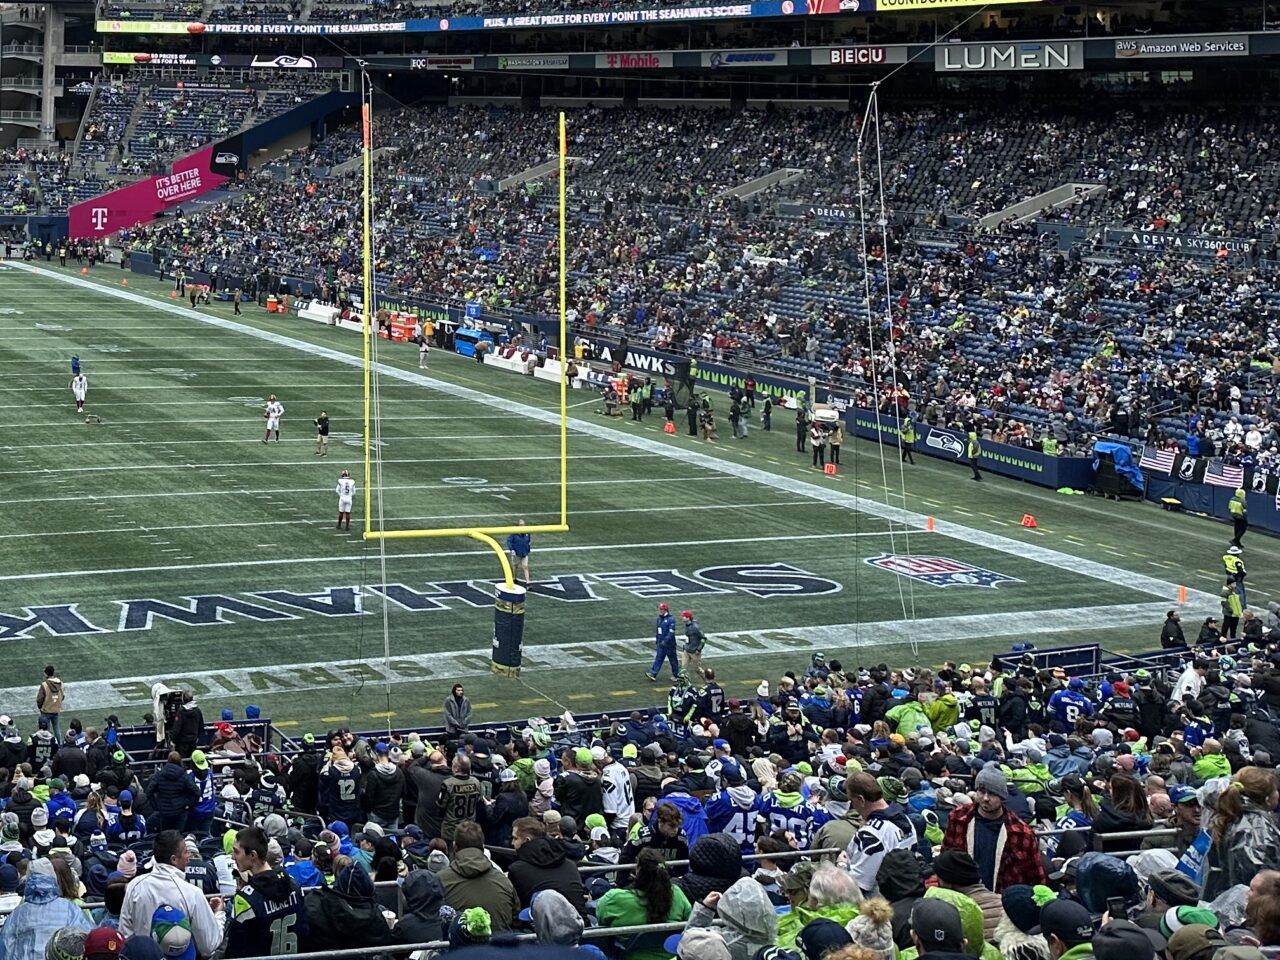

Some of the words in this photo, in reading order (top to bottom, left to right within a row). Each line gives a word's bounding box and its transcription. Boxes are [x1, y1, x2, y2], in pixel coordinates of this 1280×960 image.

[506, 18, 513, 26] A
[514, 16, 540, 26] GREAT
[542, 16, 564, 24] PRIZE
[565, 14, 582, 24] FOR
[584, 13, 609, 22] EVERY
[612, 11, 639, 21] POINT
[641, 10, 658, 20] THE
[659, 7, 712, 19] SEAHAWKS
[713, 4, 752, 17] SCORE!
[216, 24, 241, 32] PRIZE
[243, 24, 261, 32] FOR
[263, 24, 292, 32] EVERY
[294, 24, 322, 33] POINT
[324, 24, 340, 32] THE
[340, 23, 378, 32] SEAHAWKS
[380, 22, 406, 31] SCORE!
[945, 44, 1069, 69] LUMEN
[1116, 42, 1136, 50] aws
[1140, 44, 1177, 53] Amazon
[1180, 43, 1200, 52] Web
[1205, 42, 1244, 51] Services
[156, 174, 170, 190] IT'S
[170, 167, 200, 185] BETTER
[157, 184, 180, 199] OVER
[180, 178, 202, 192] HERE
[92, 208, 108, 230] T
[818, 208, 846, 218] DELTA
[854, 700, 860, 714] 6
[980, 708, 995, 724] 14
[1066, 705, 1080, 722] 8
[338, 779, 356, 800] 12
[454, 794, 478, 818] 80
[722, 812, 758, 844] 45
[270, 913, 298, 954] 16
